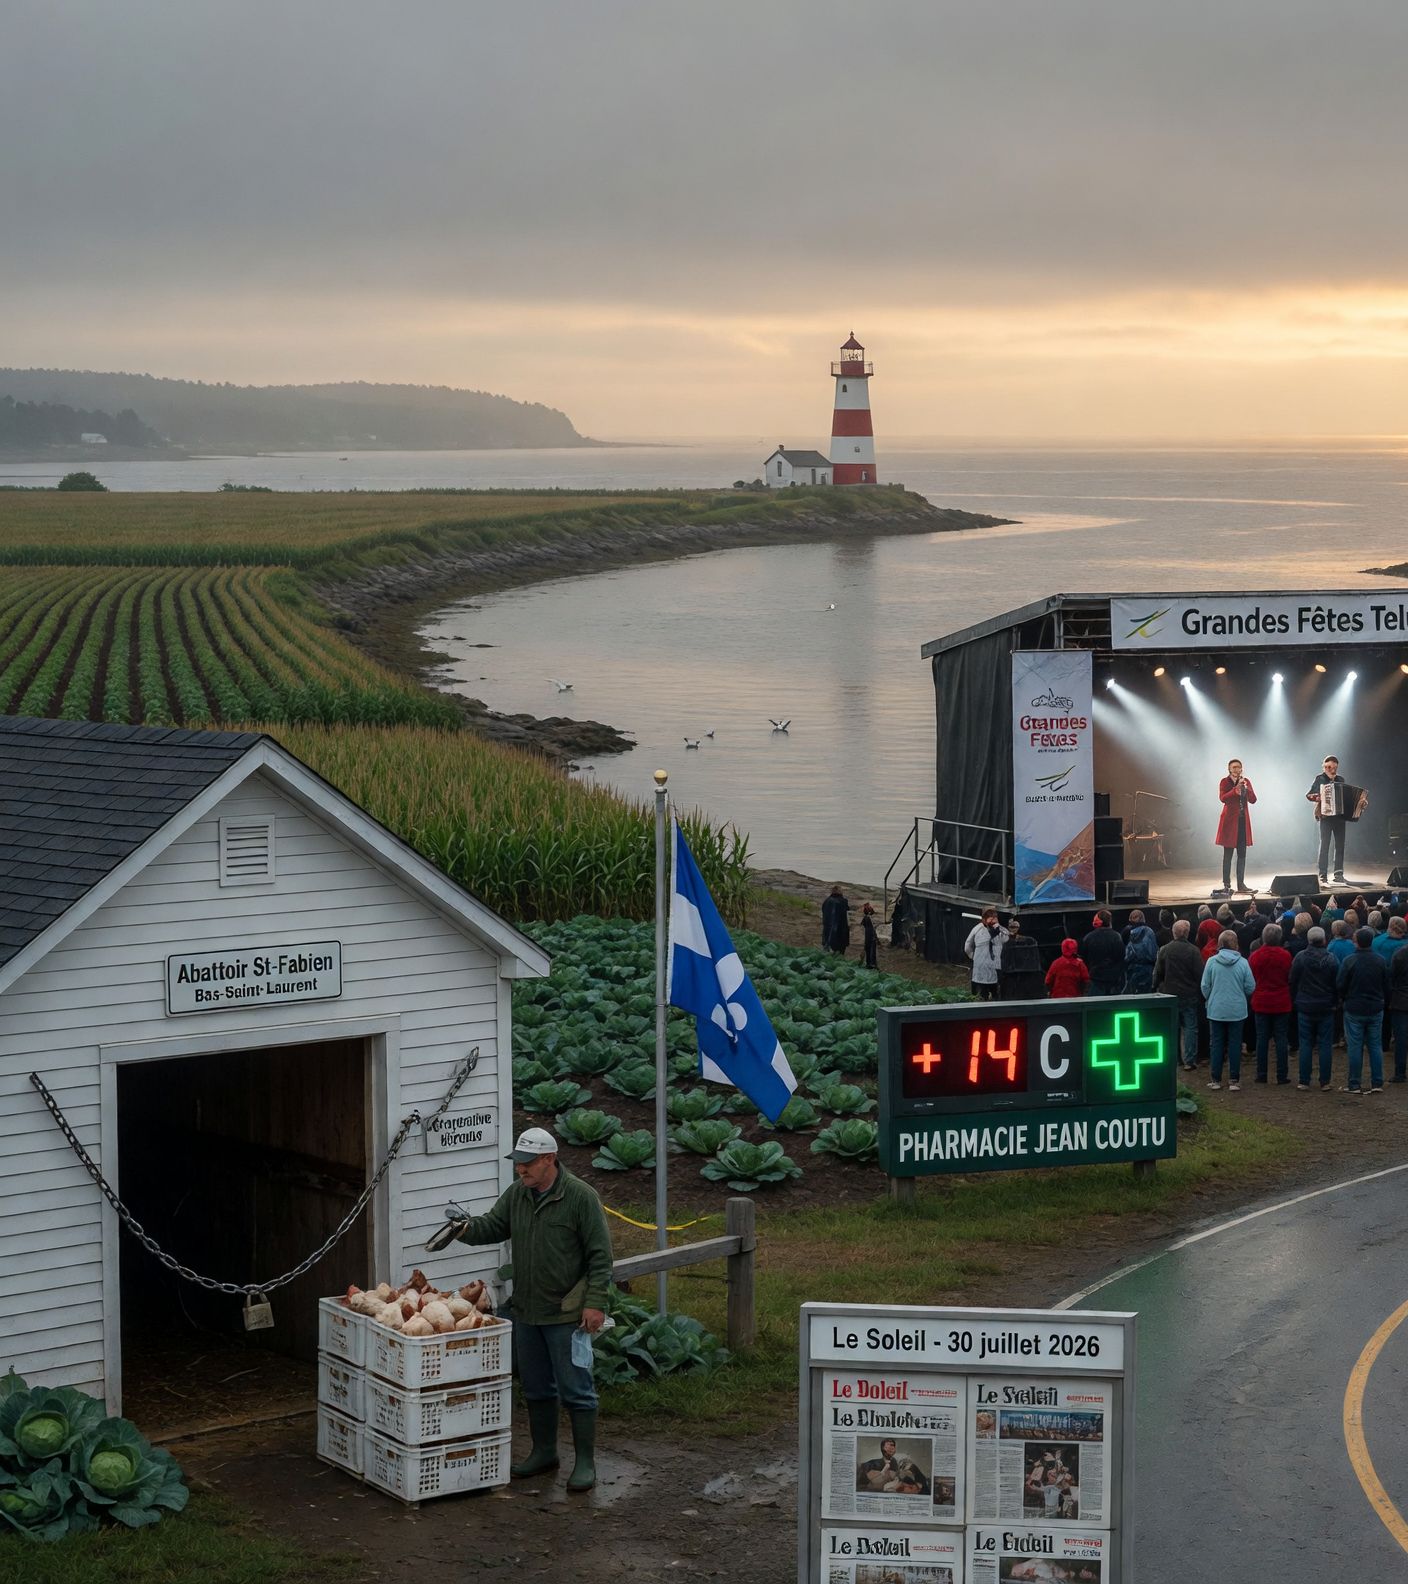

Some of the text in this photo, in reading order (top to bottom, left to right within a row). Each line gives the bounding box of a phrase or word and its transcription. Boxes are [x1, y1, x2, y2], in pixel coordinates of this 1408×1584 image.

[1181, 607, 1290, 636] Grandes
[1298, 606, 1364, 633] Fêtes
[177, 953, 333, 984] Abattoir St-Fabien
[968, 1028, 1019, 1083] 14
[1040, 1025, 1070, 1079] C
[899, 1116, 1166, 1162] PHARMACIE JEAN COUTU
[832, 1326, 858, 1349] Le
[866, 1327, 926, 1351] Soleil
[947, 1331, 973, 1352] 30
[978, 1332, 1041, 1359] juillet
[1049, 1334, 1100, 1357] 2026
[832, 1379, 852, 1398] Le
[976, 1383, 998, 1404] Le
[829, 1535, 852, 1555] Le
[973, 1530, 996, 1551] Le
